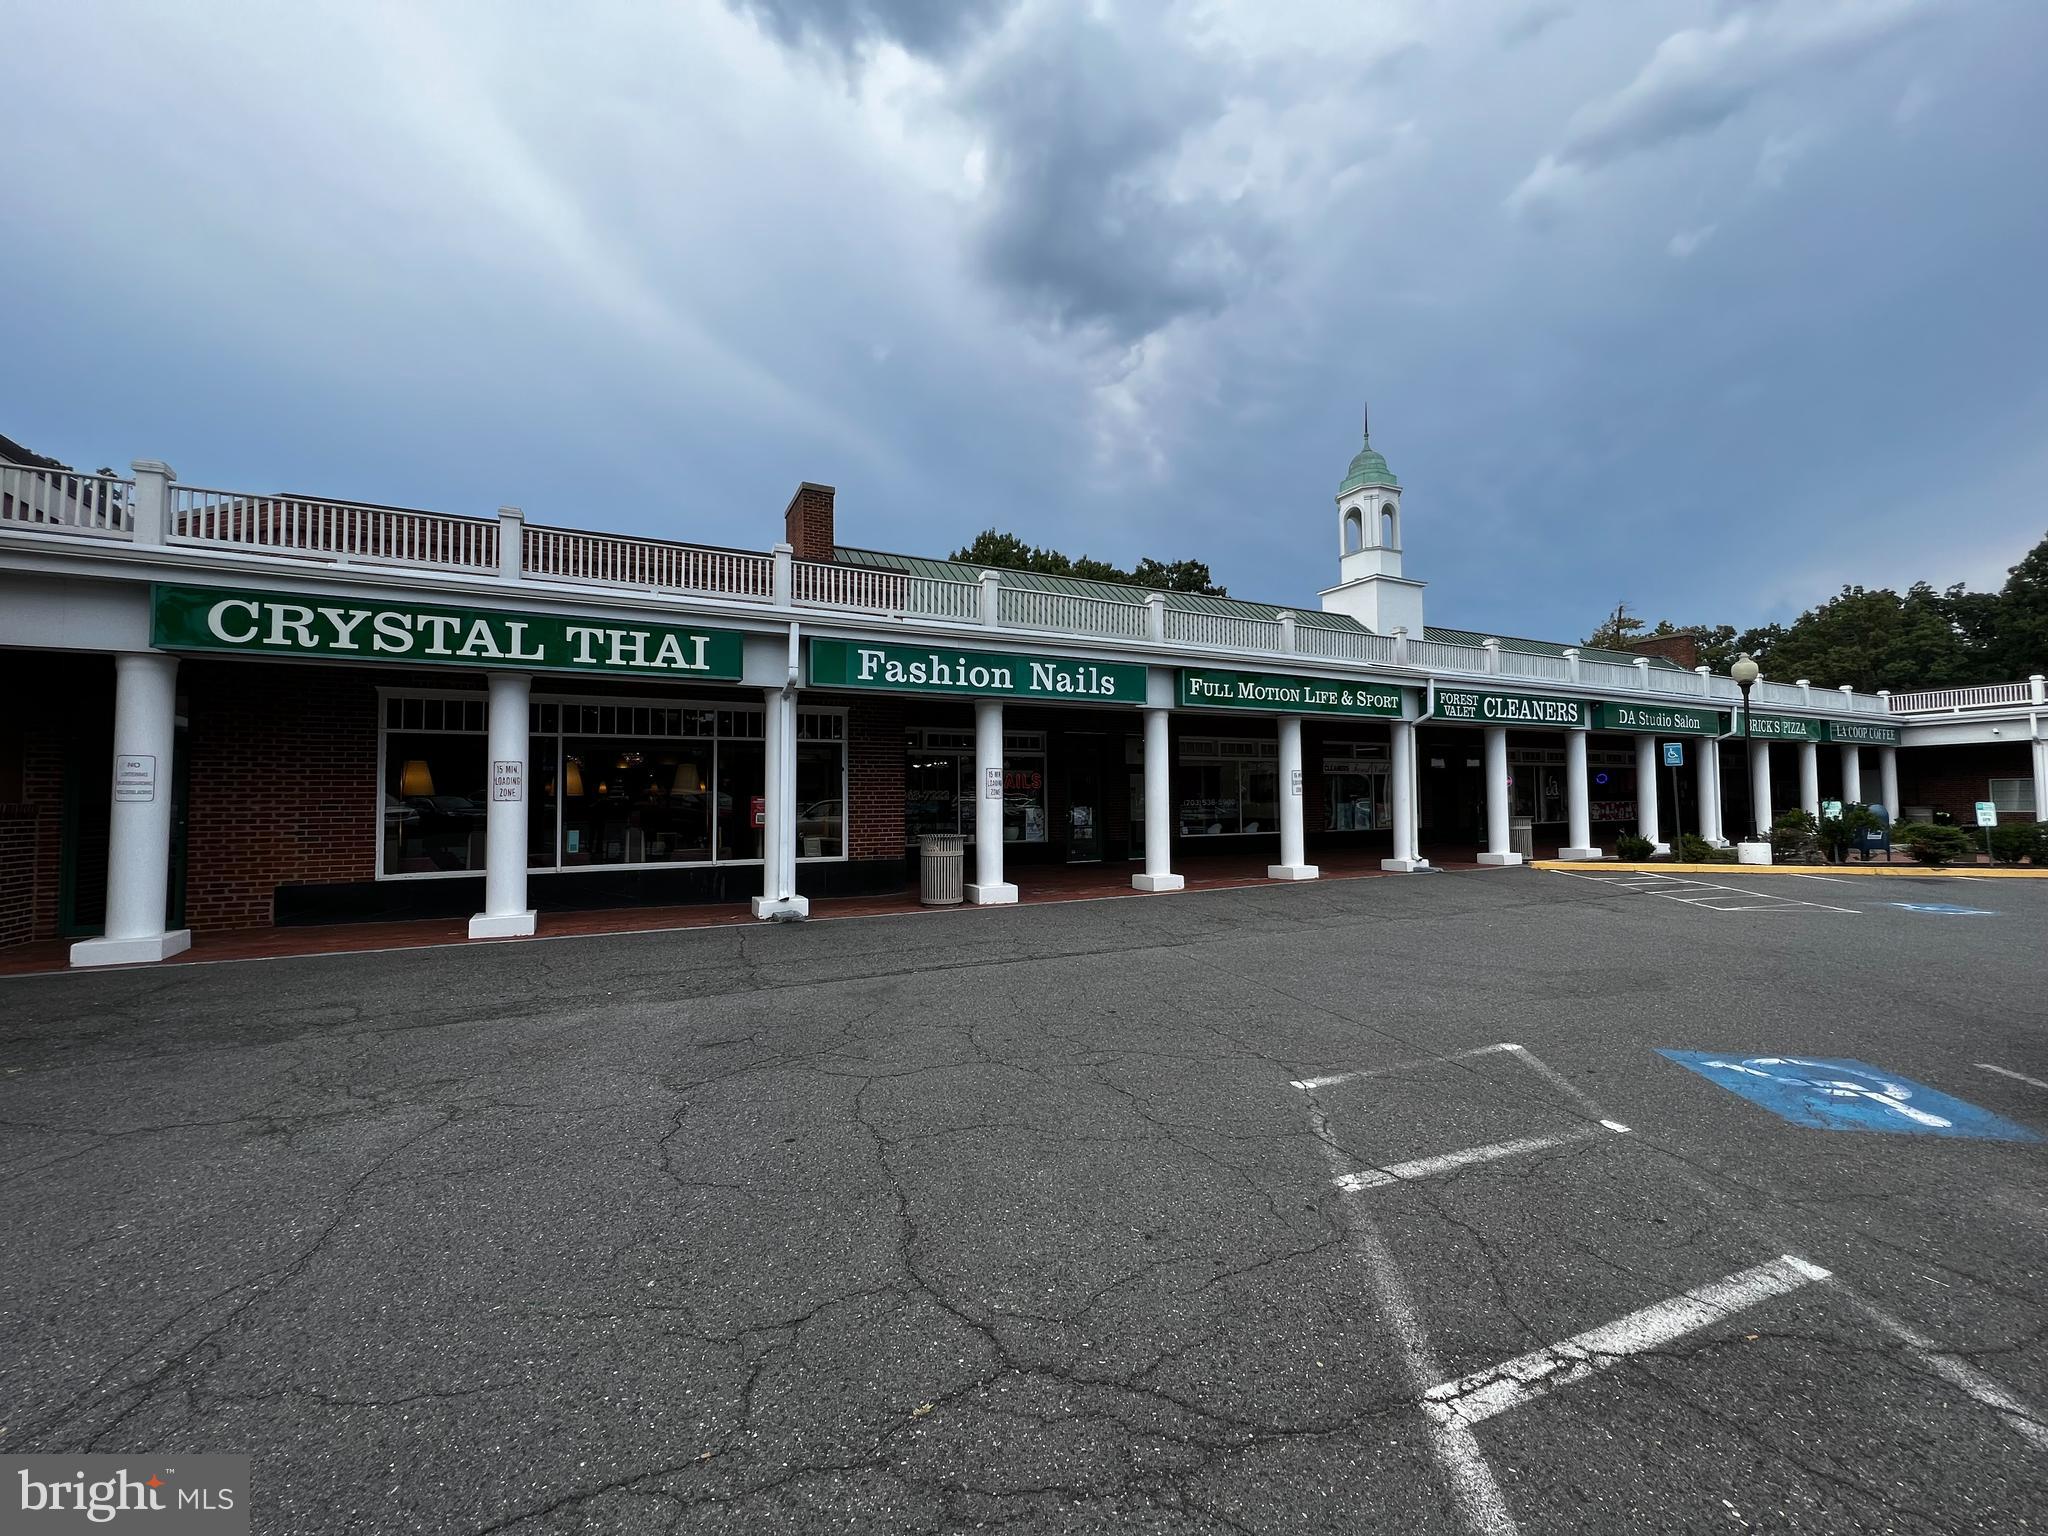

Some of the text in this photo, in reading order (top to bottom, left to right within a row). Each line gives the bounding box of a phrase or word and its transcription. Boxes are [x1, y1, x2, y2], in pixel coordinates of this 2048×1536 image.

[207, 599, 710, 671] CRYSTAL THAI
[857, 649, 1115, 695] Fashion Nails
[1189, 678, 1399, 709] FULL MOTION LIFE & SPORT
[1440, 692, 1479, 706] FOREST
[1444, 705, 1476, 717] VALET
[1483, 697, 1578, 722] CLEANERS
[1618, 709, 1701, 729] DA Studio Salon
[1782, 721, 1807, 735] PIZZA
[1836, 725, 1896, 741] LA COOP COFFEE
[496, 765, 503, 774] 15
[495, 777, 521, 785] LOADING
[1003, 771, 1042, 789] AILS
[499, 788, 516, 797] ZONE
